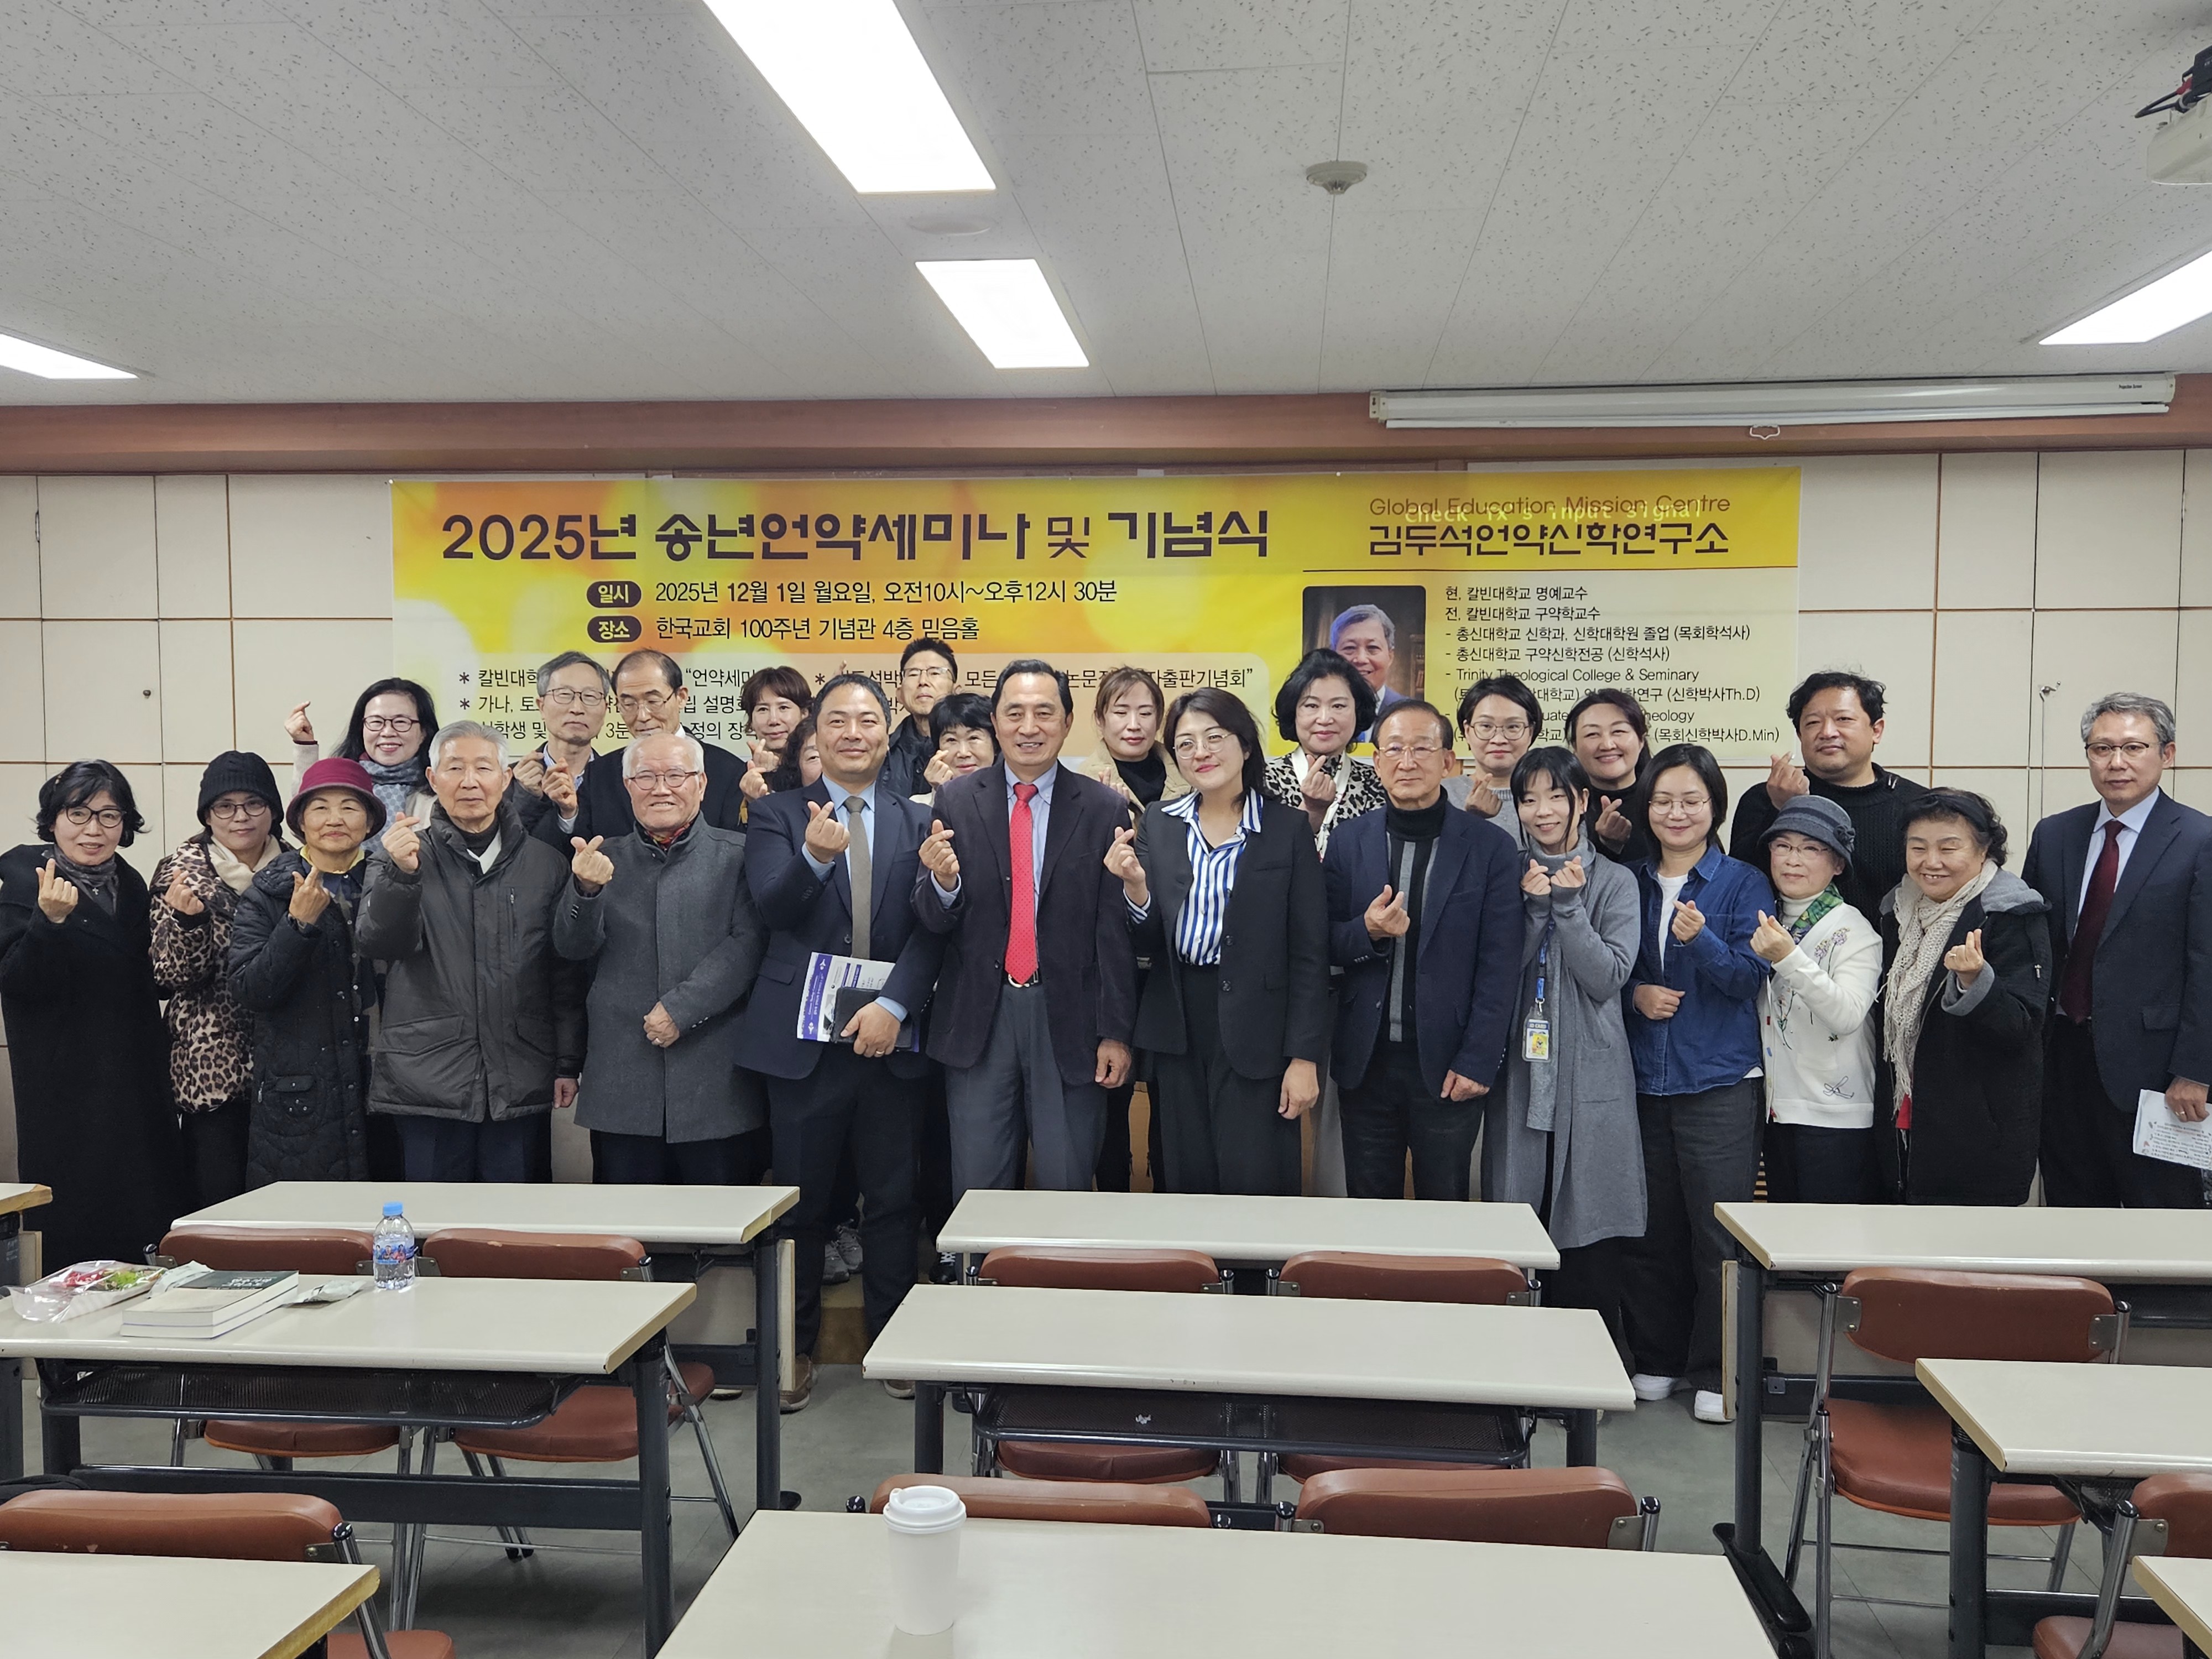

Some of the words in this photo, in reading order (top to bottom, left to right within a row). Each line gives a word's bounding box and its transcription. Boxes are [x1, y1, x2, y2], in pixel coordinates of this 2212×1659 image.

[1370, 498, 1438, 515] Global
[1448, 497, 1555, 515] Education
[1566, 495, 1646, 513] Mission
[1656, 494, 1730, 512] Centre
[442, 514, 637, 561] 2025년
[655, 513, 1031, 562] 송년언약세미나
[1047, 517, 1090, 559] 및
[1108, 510, 1268, 559] 기념식
[1370, 523, 1729, 556] 김두석언약신학연구소
[597, 584, 629, 604] 일시
[656, 581, 718, 603] 2025년
[727, 581, 768, 603] 12월
[776, 581, 805, 603] 1일
[813, 581, 875, 603] 월요일,
[883, 580, 1065, 603] 오전10시~오후12시
[1074, 580, 1117, 602] 30분
[1467, 586, 1531, 601] 칼빈대학교
[1536, 586, 1588, 601] 명예교수
[1467, 607, 1531, 621] 칼빈대학교
[1535, 606, 1600, 622] 구약학교수
[598, 620, 630, 640] 장소
[656, 617, 730, 639] 한국교회
[740, 618, 810, 640] 100주년
[819, 618, 877, 640] 기념관
[882, 617, 914, 639] 4층
[922, 617, 979, 640] 믿음홀
[1456, 627, 1521, 641] 총신대학교
[1526, 627, 1568, 641] 신학과,
[1573, 627, 1639, 641] 신학대학원
[1644, 626, 1669, 641] 졸업
[1674, 625, 1750, 641] (목회학석사)
[1456, 647, 1521, 662] 총신대학교
[1525, 647, 1604, 662] 구약신학전공
[1608, 646, 1670, 662] (신학석사)
[478, 669, 537, 687] 칼빈대학
[964, 670, 998, 688] 모든
[1456, 667, 1493, 680] Trinity
[1496, 668, 1568, 683] Theological
[1573, 669, 1621, 683] College
[1625, 668, 1634, 681] &
[1639, 668, 1699, 682] Seminary
[1667, 686, 1760, 702] (신학박사Th.D)
[478, 695, 514, 713] 가나,
[1655, 727, 1780, 743] (목회신학박사D.Min)
